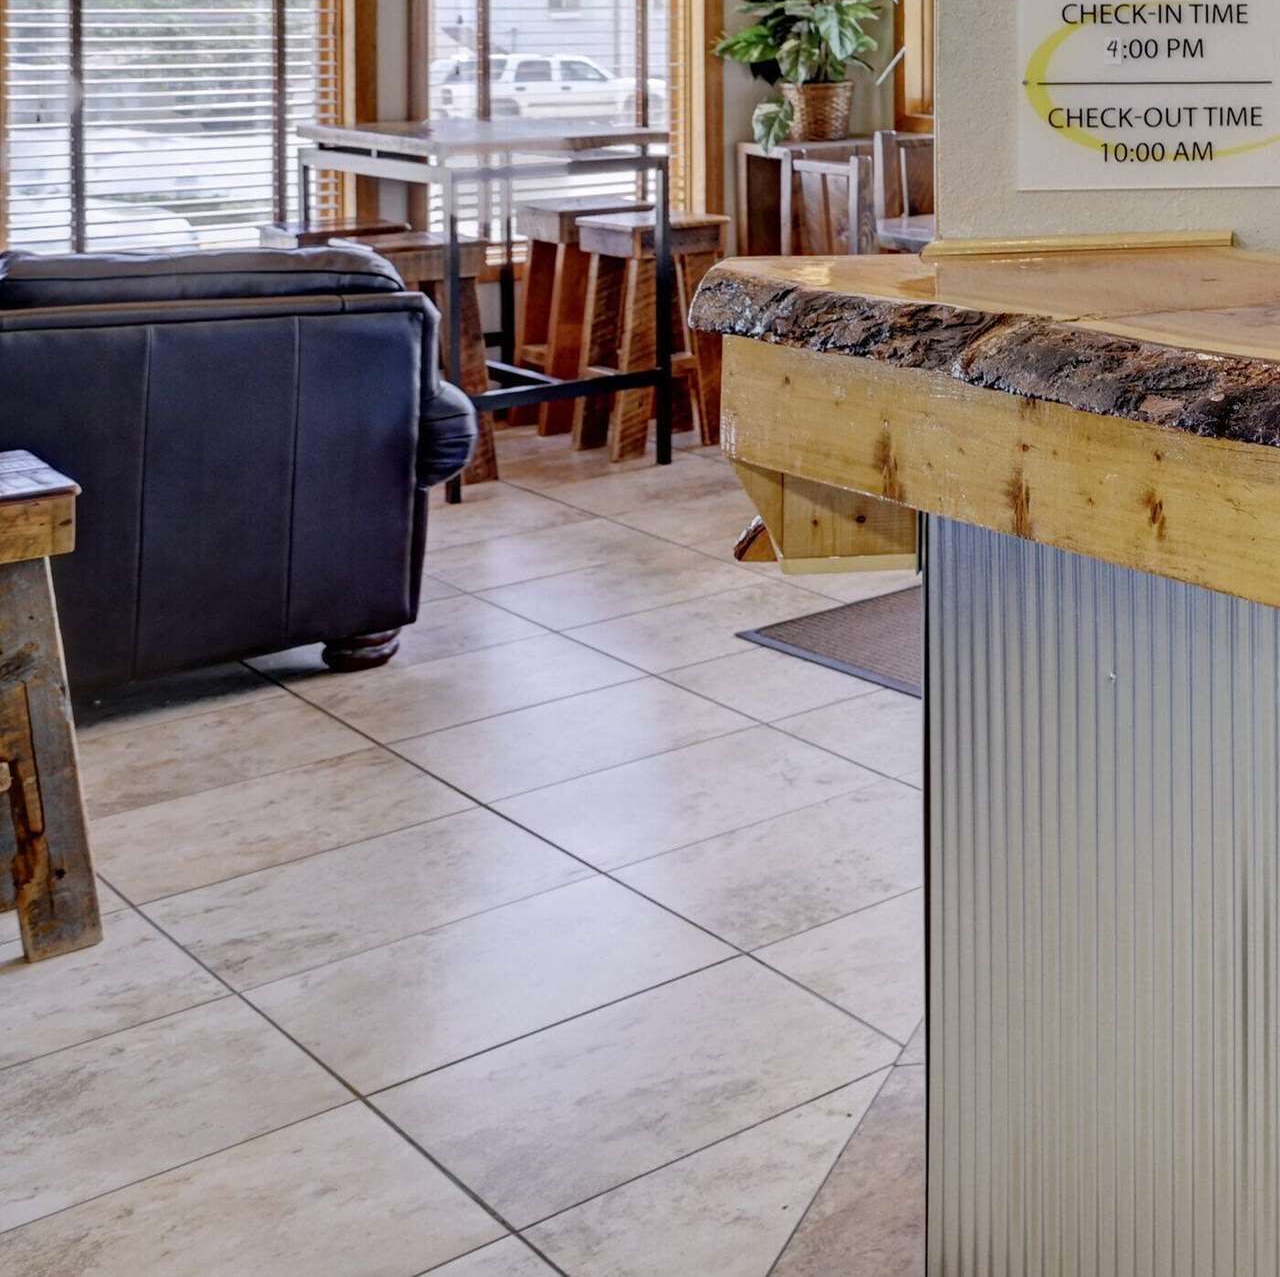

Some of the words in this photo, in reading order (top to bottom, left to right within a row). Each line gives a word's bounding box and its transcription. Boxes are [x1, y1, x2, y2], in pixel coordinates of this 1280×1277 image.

[1061, 3, 1183, 24] CHECK-IN
[1189, 3, 1249, 24] TIME
[1106, 38, 1159, 59] 4:00
[1167, 38, 1205, 58] PM
[1047, 106, 1198, 129] CHECK-OUT
[1203, 106, 1263, 127] TIME
[1100, 142, 1165, 163] 10:00
[1172, 141, 1214, 162] AM
